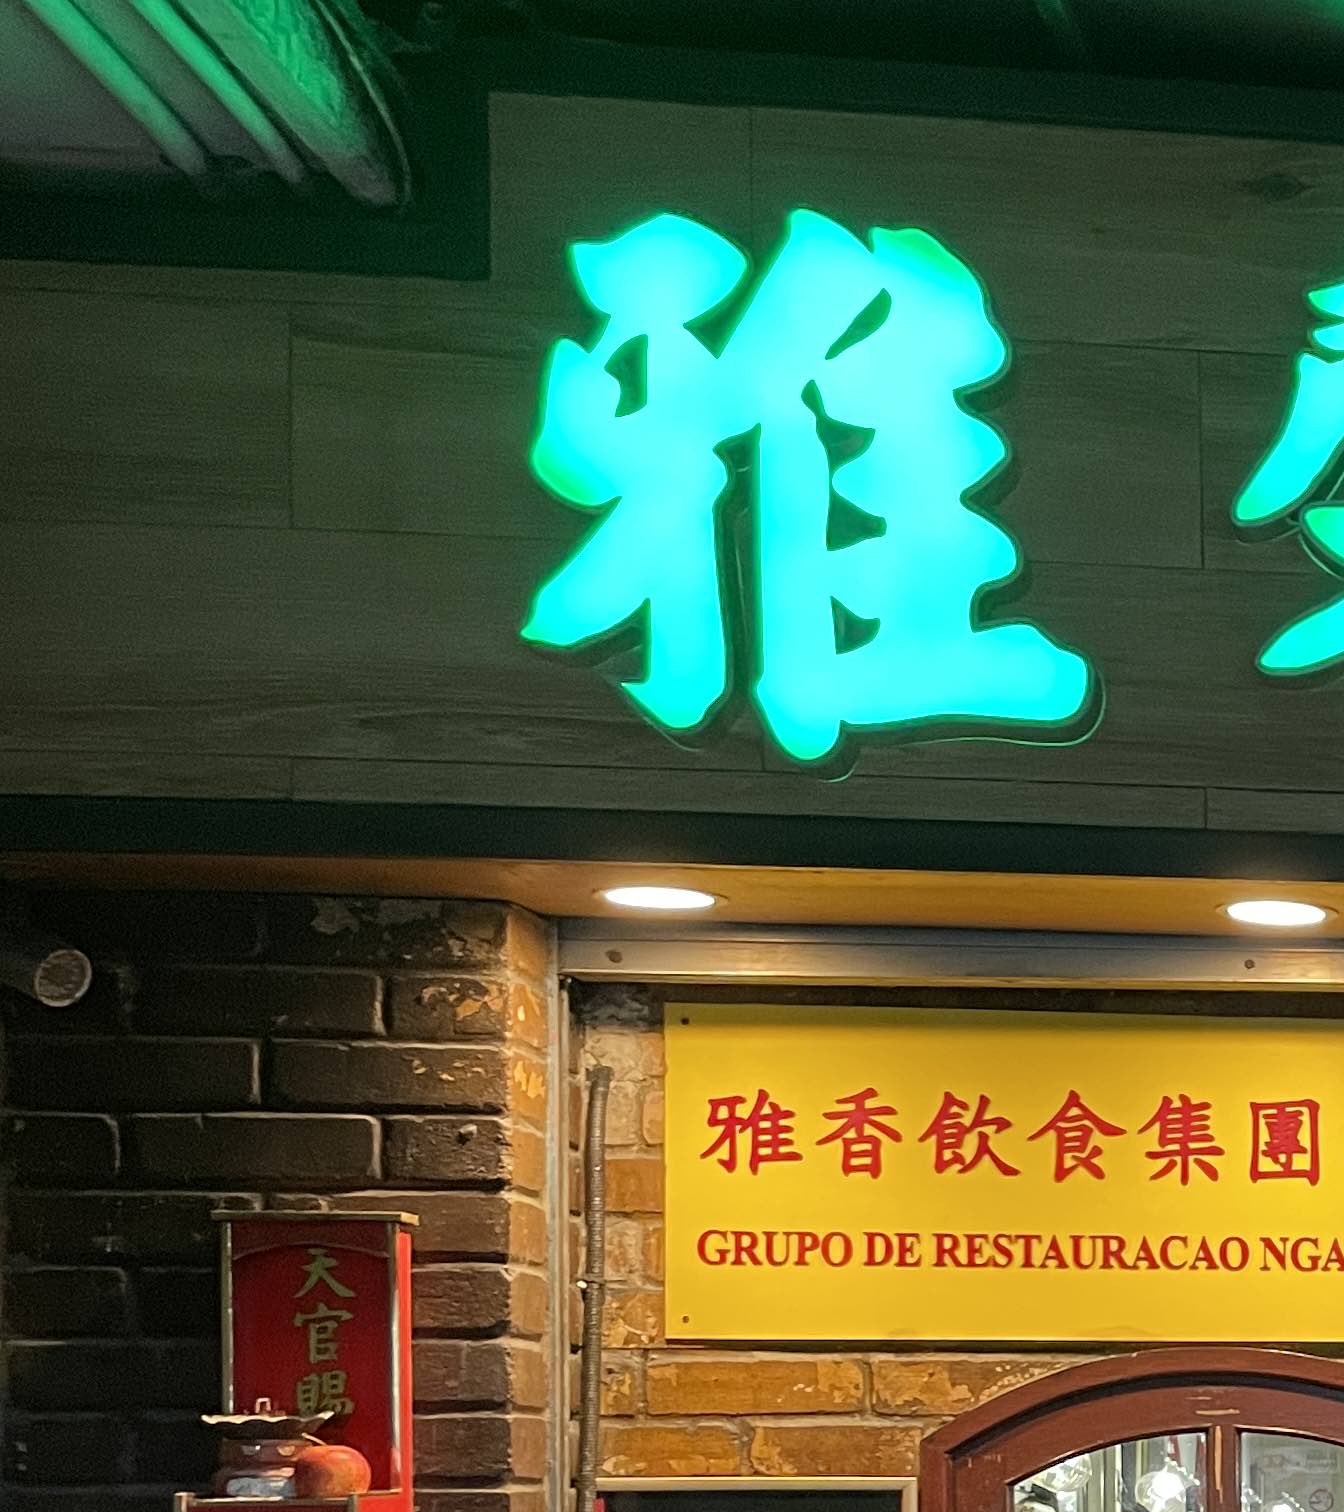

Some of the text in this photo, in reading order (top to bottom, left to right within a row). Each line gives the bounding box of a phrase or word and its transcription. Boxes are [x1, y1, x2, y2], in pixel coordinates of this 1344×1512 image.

[696, 1229, 855, 1270] GRUPO
[864, 1231, 924, 1271] DE
[933, 1231, 1251, 1274] RESTAURACAO
